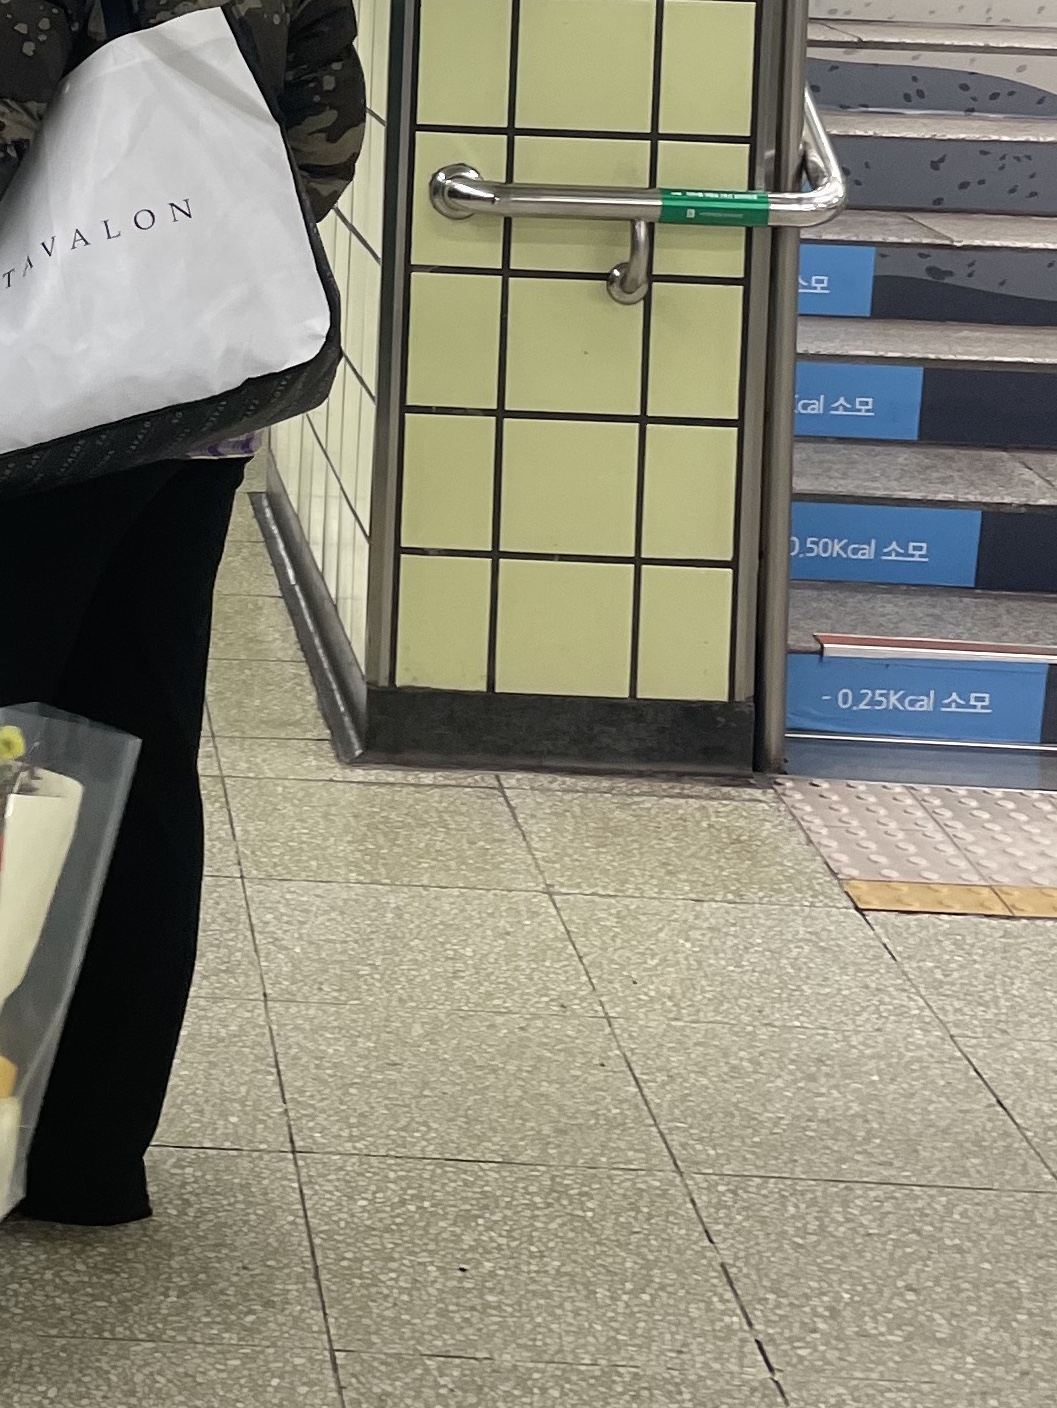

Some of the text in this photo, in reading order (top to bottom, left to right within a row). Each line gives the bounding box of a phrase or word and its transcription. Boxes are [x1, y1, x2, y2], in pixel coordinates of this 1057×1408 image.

[2, 198, 192, 288] TAVALON
[794, 395, 875, 416] cal 소모
[880, 541, 929, 562] 소모
[940, 692, 992, 713] 소모
